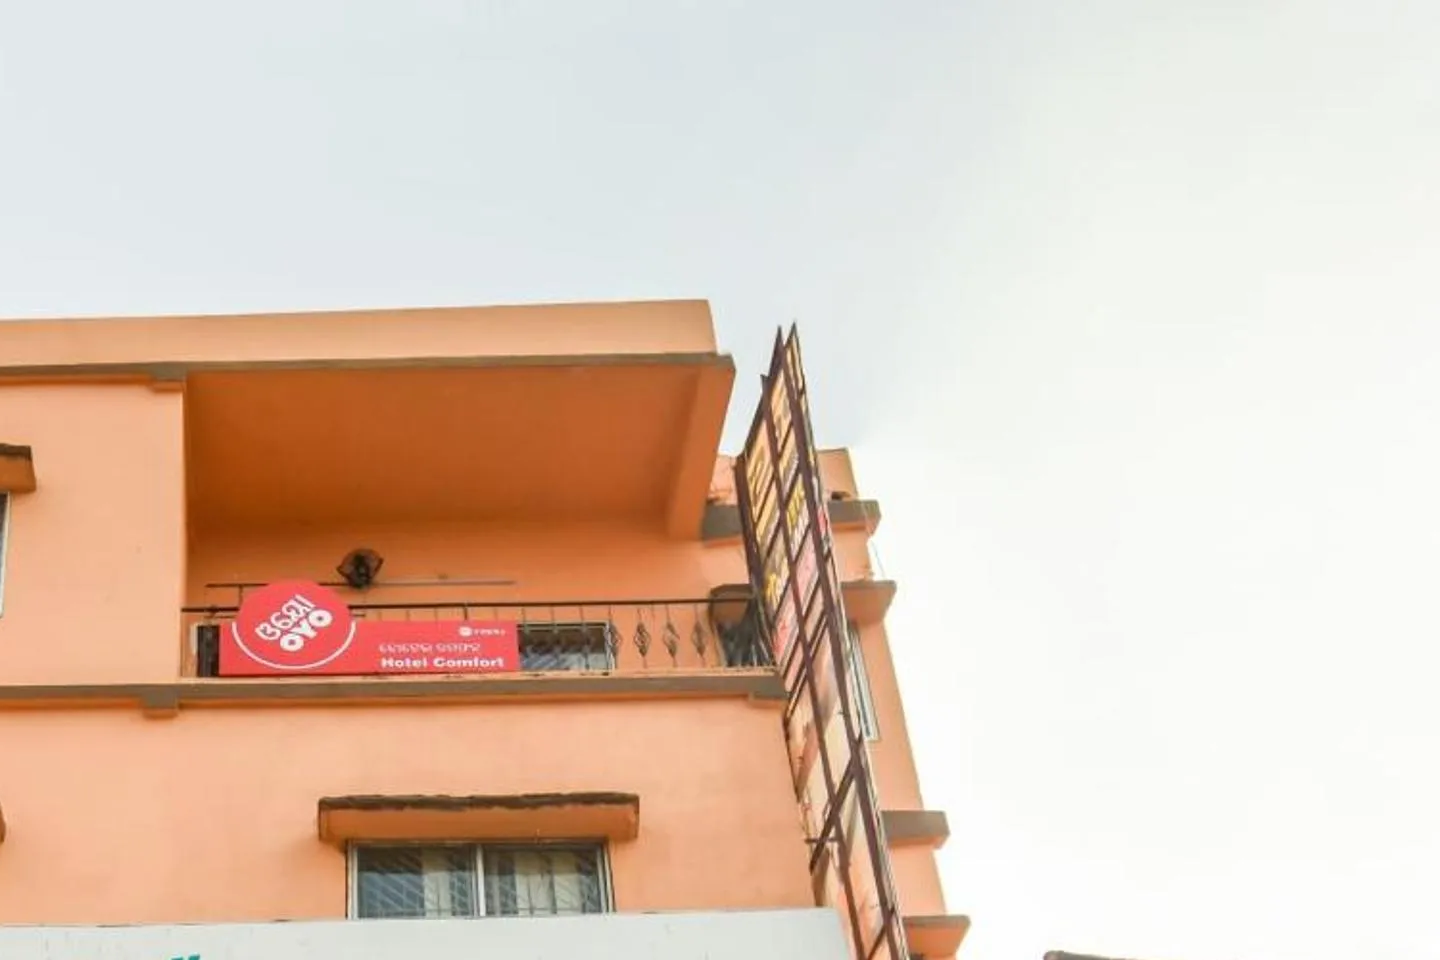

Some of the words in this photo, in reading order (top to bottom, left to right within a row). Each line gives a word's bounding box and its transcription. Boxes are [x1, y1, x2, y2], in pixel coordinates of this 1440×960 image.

[279, 609, 334, 653] OYO
[380, 656, 428, 668] Hotel
[432, 656, 504, 668] Comfort
